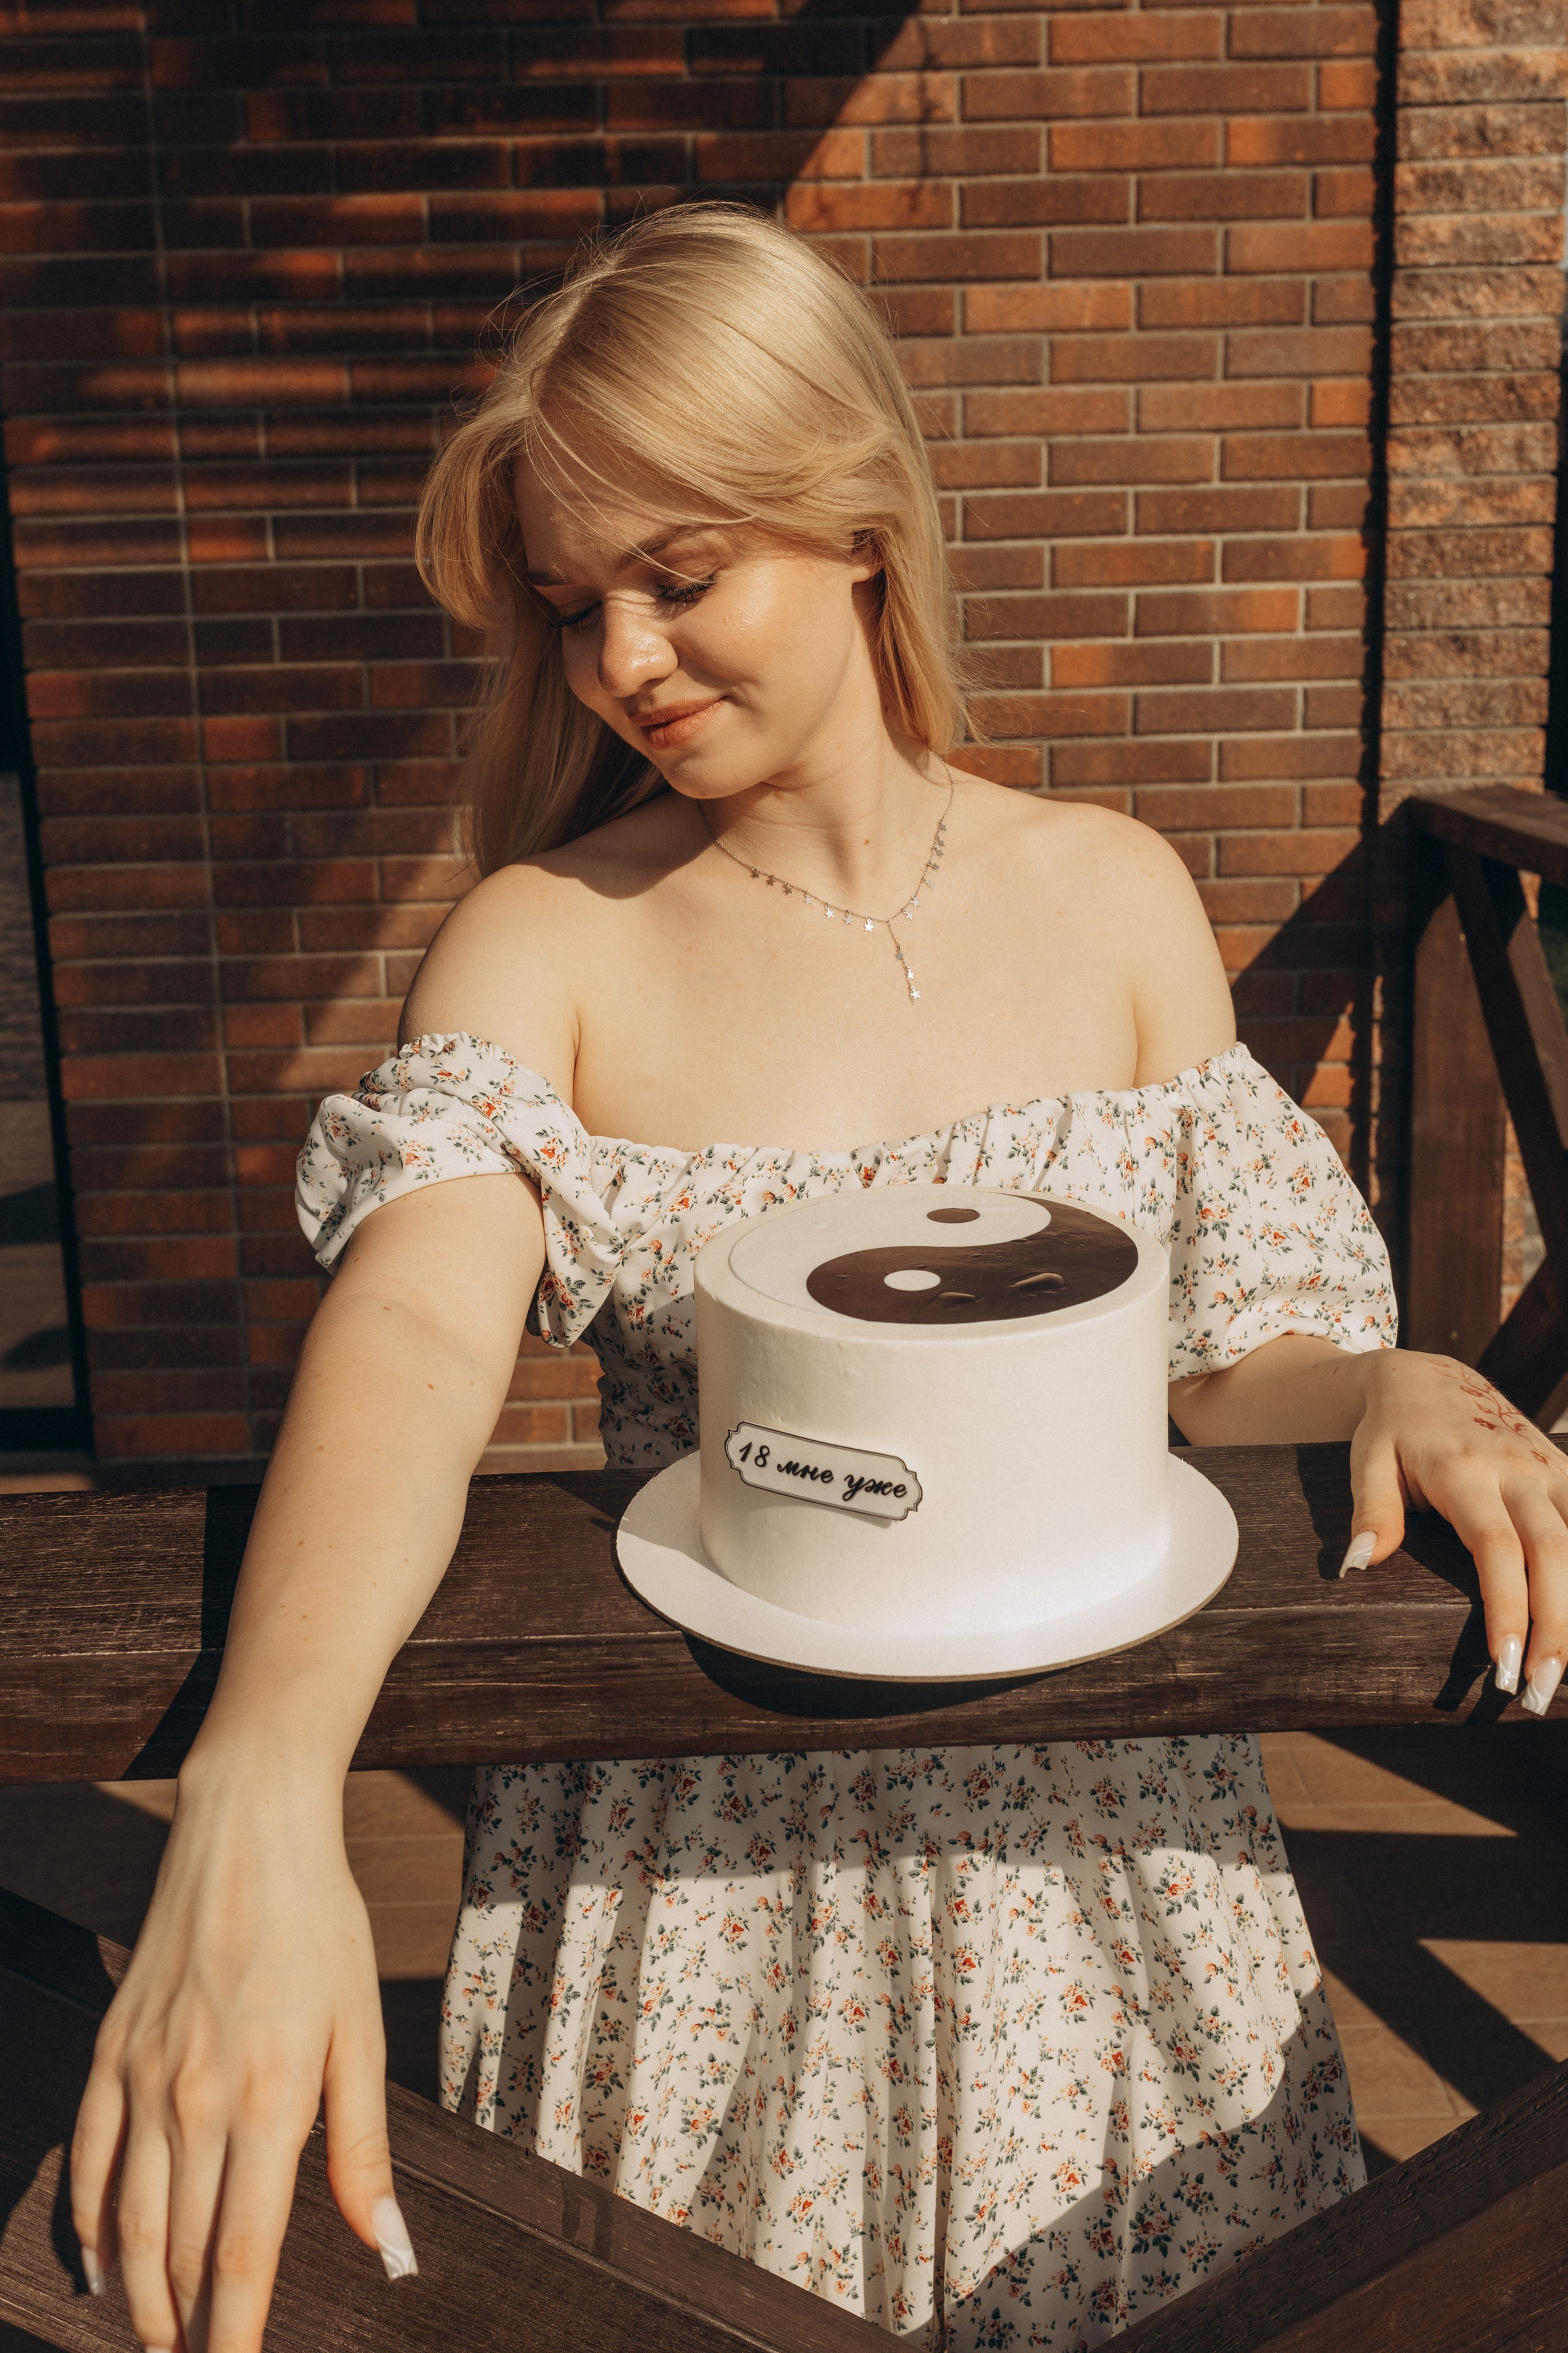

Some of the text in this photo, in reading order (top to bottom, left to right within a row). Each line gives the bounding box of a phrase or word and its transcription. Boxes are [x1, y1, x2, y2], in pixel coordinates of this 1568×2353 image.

[739, 1441, 907, 1501] 18 мне уже
